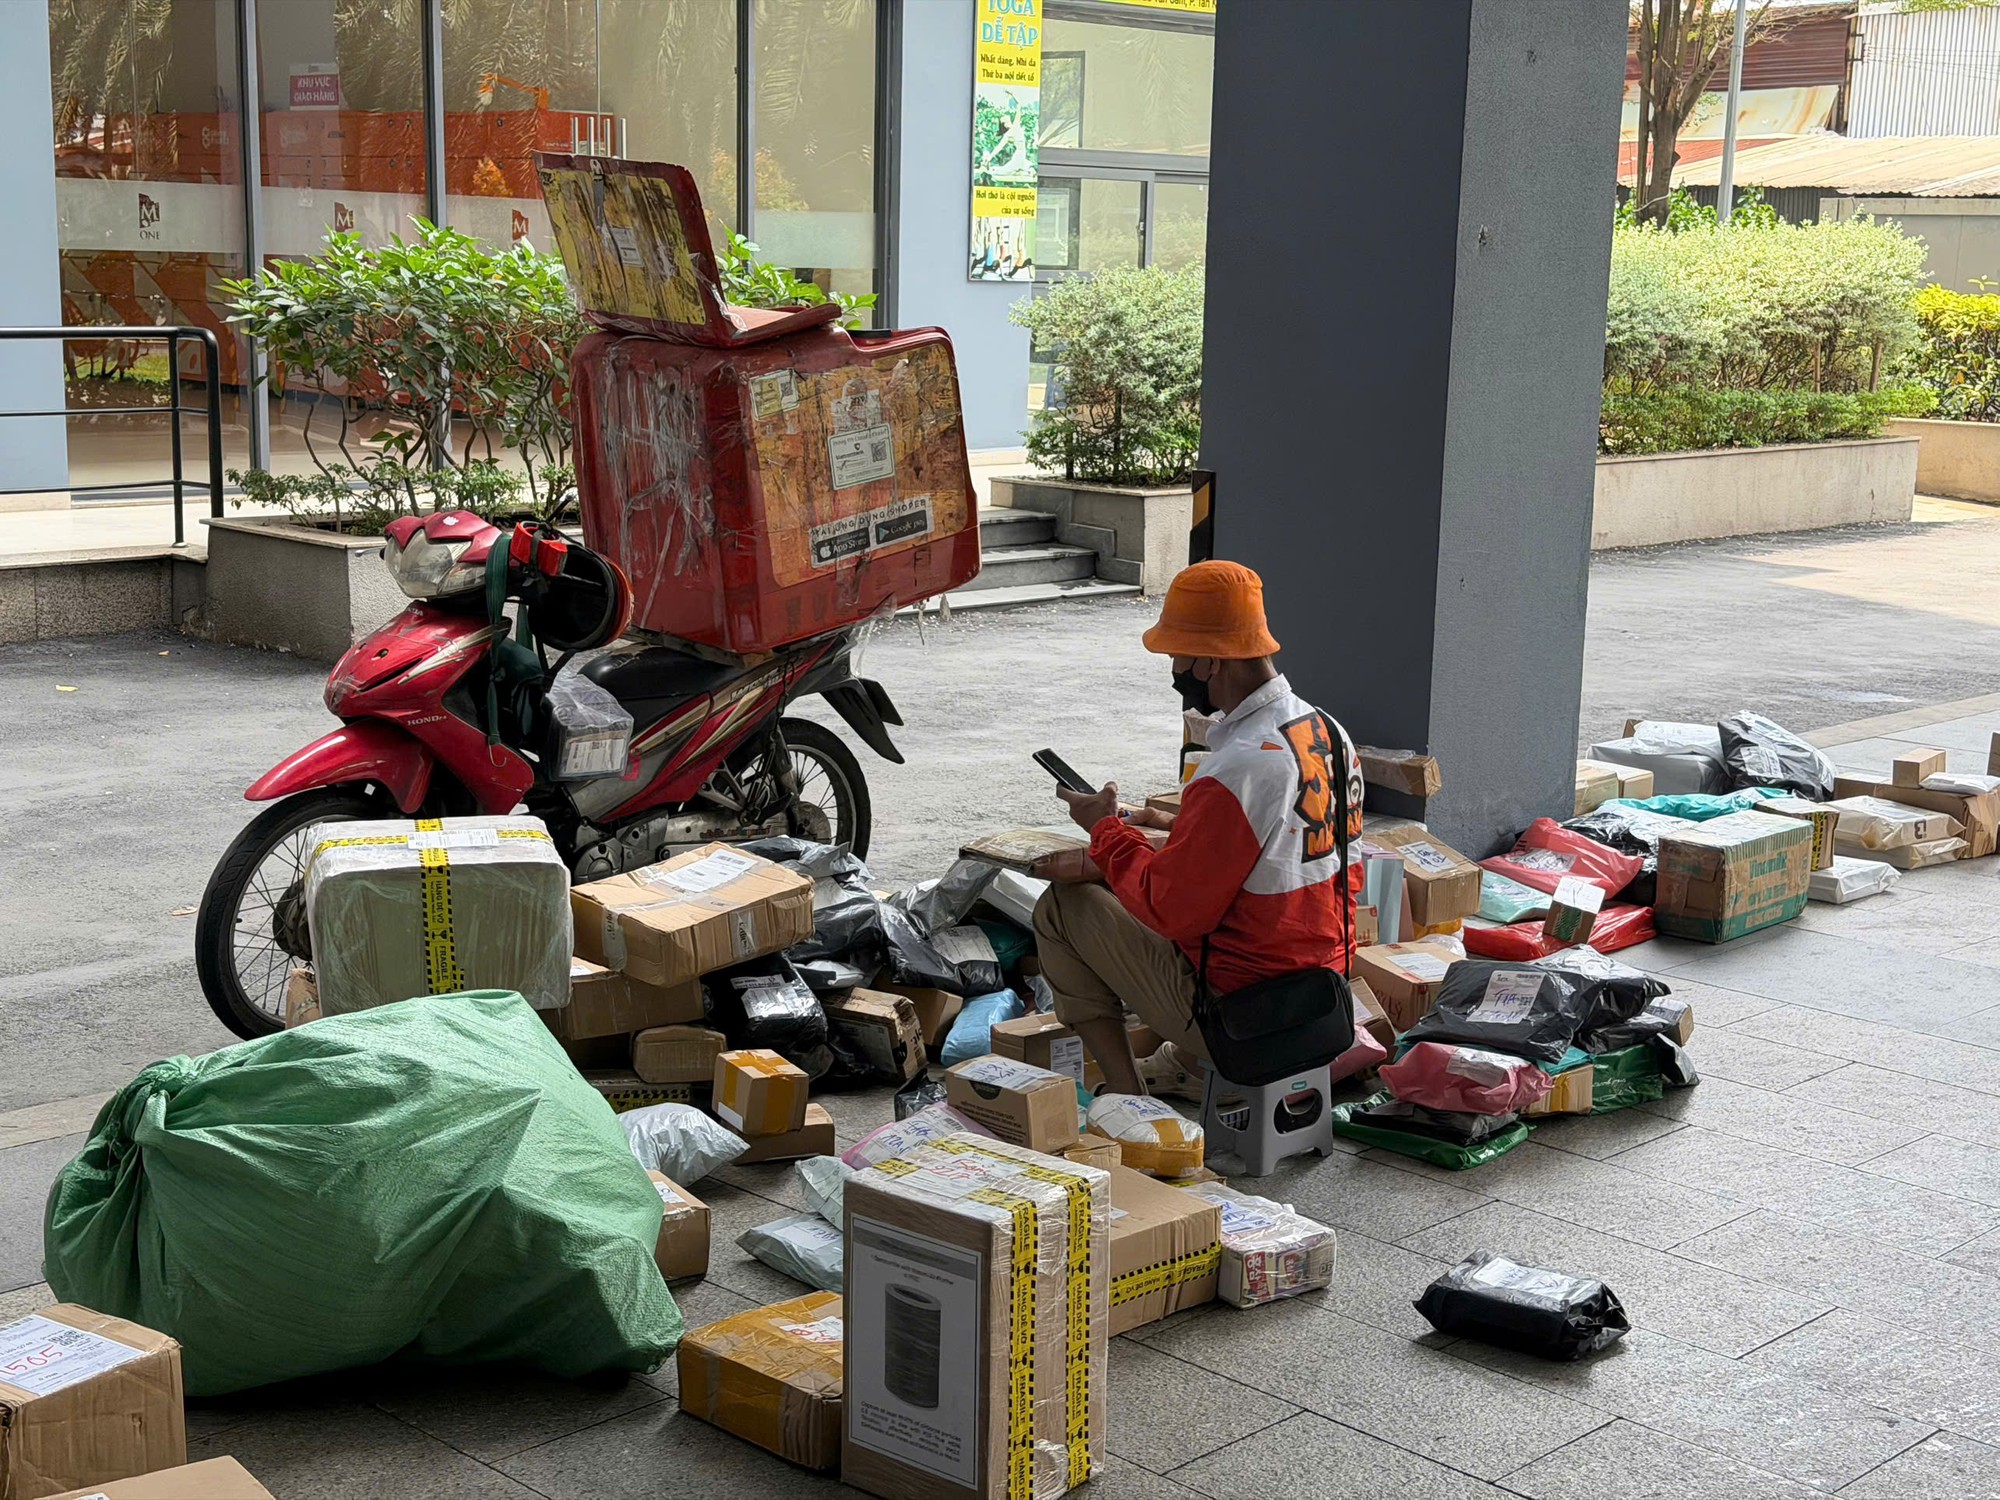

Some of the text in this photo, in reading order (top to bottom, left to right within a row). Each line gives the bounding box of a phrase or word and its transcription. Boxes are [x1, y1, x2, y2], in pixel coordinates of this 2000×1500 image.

[981, 16, 1038, 51] DỄ TẬP
[407, 714, 448, 726] HONDA
[439, 945, 449, 981] FRAGILE
[1017, 1203, 1030, 1251] FRAGILE
[1077, 1201, 1085, 1251] FRAGILE
[1177, 1262, 1206, 1279] FRAGILE
[1018, 1374, 1026, 1425] FRAGILE
